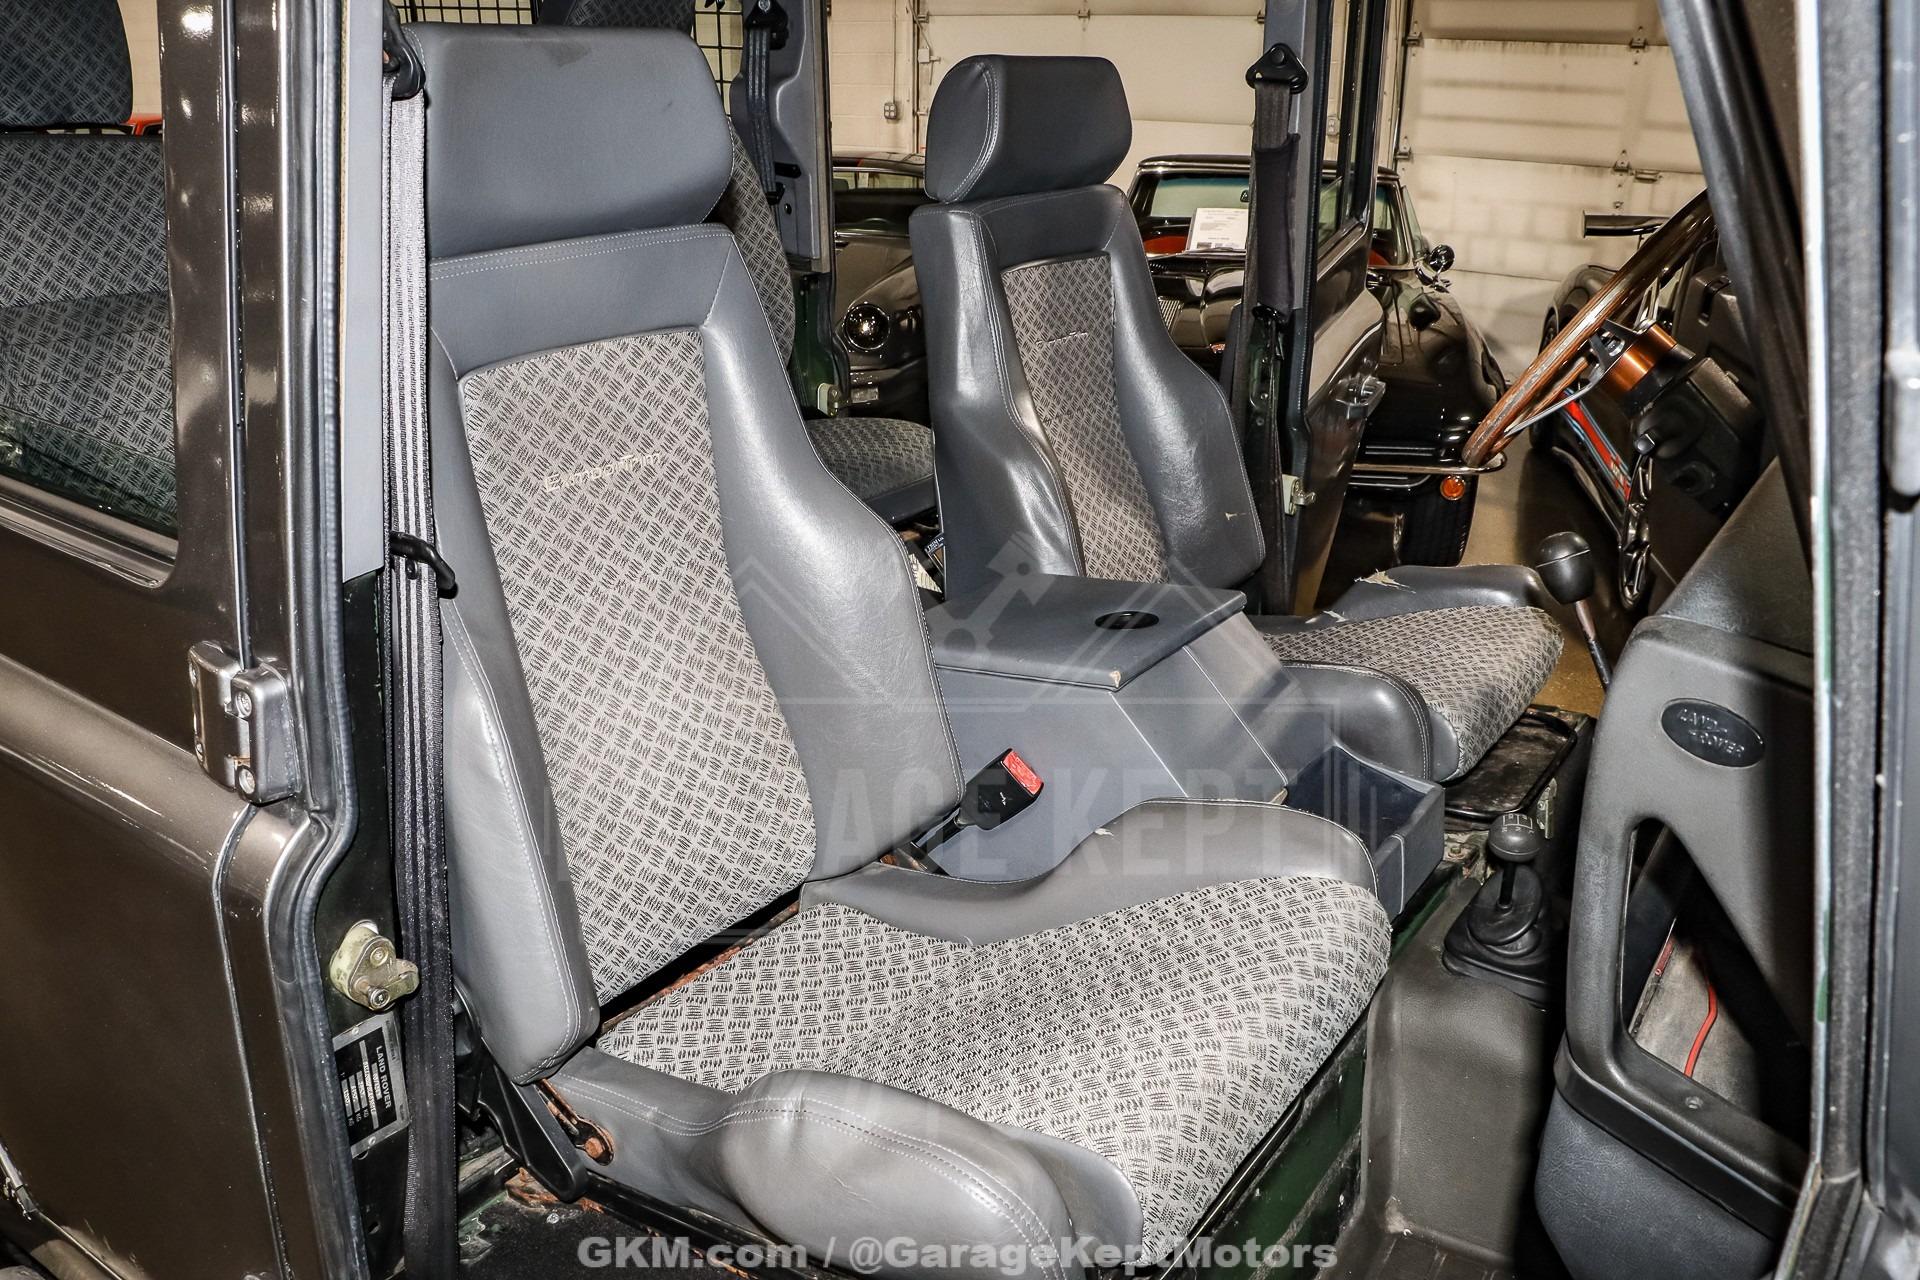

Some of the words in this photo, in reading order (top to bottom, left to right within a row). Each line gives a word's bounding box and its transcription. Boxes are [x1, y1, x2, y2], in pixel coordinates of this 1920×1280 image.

[1678, 707, 1718, 730] LAND
[1700, 732, 1745, 758] ROVER
[376, 1045, 386, 1072] LAND
[381, 1075, 392, 1109] ROVER
